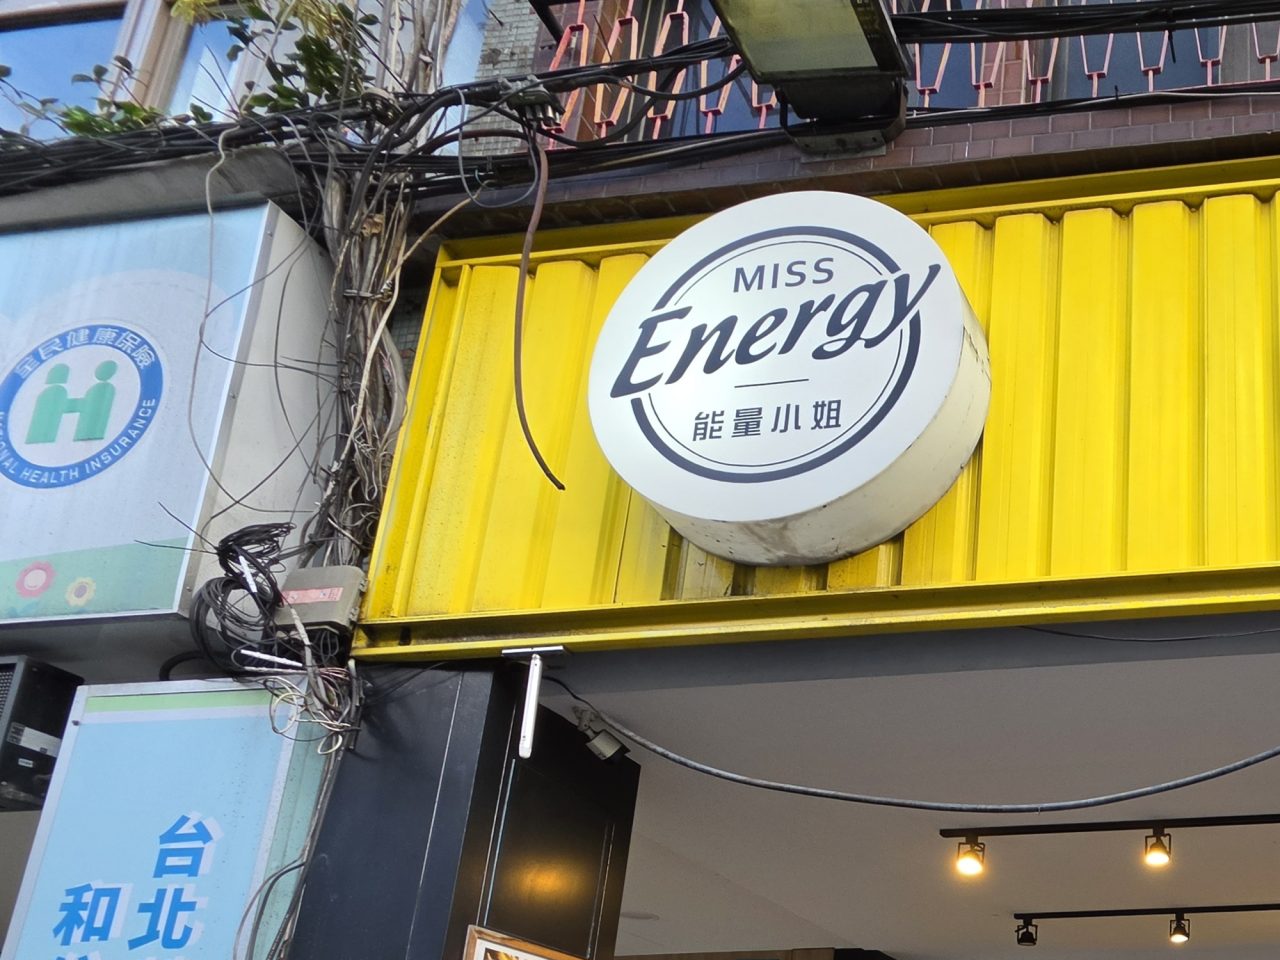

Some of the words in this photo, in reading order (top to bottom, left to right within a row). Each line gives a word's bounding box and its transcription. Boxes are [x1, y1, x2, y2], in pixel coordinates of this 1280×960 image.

[733, 257, 835, 293] MISS
[15, 328, 156, 380] 全民健康保險
[610, 264, 941, 398] Energy
[19, 467, 79, 484] HEALTH
[85, 398, 156, 474] INSURANCE
[692, 399, 842, 442] 能量小姐
